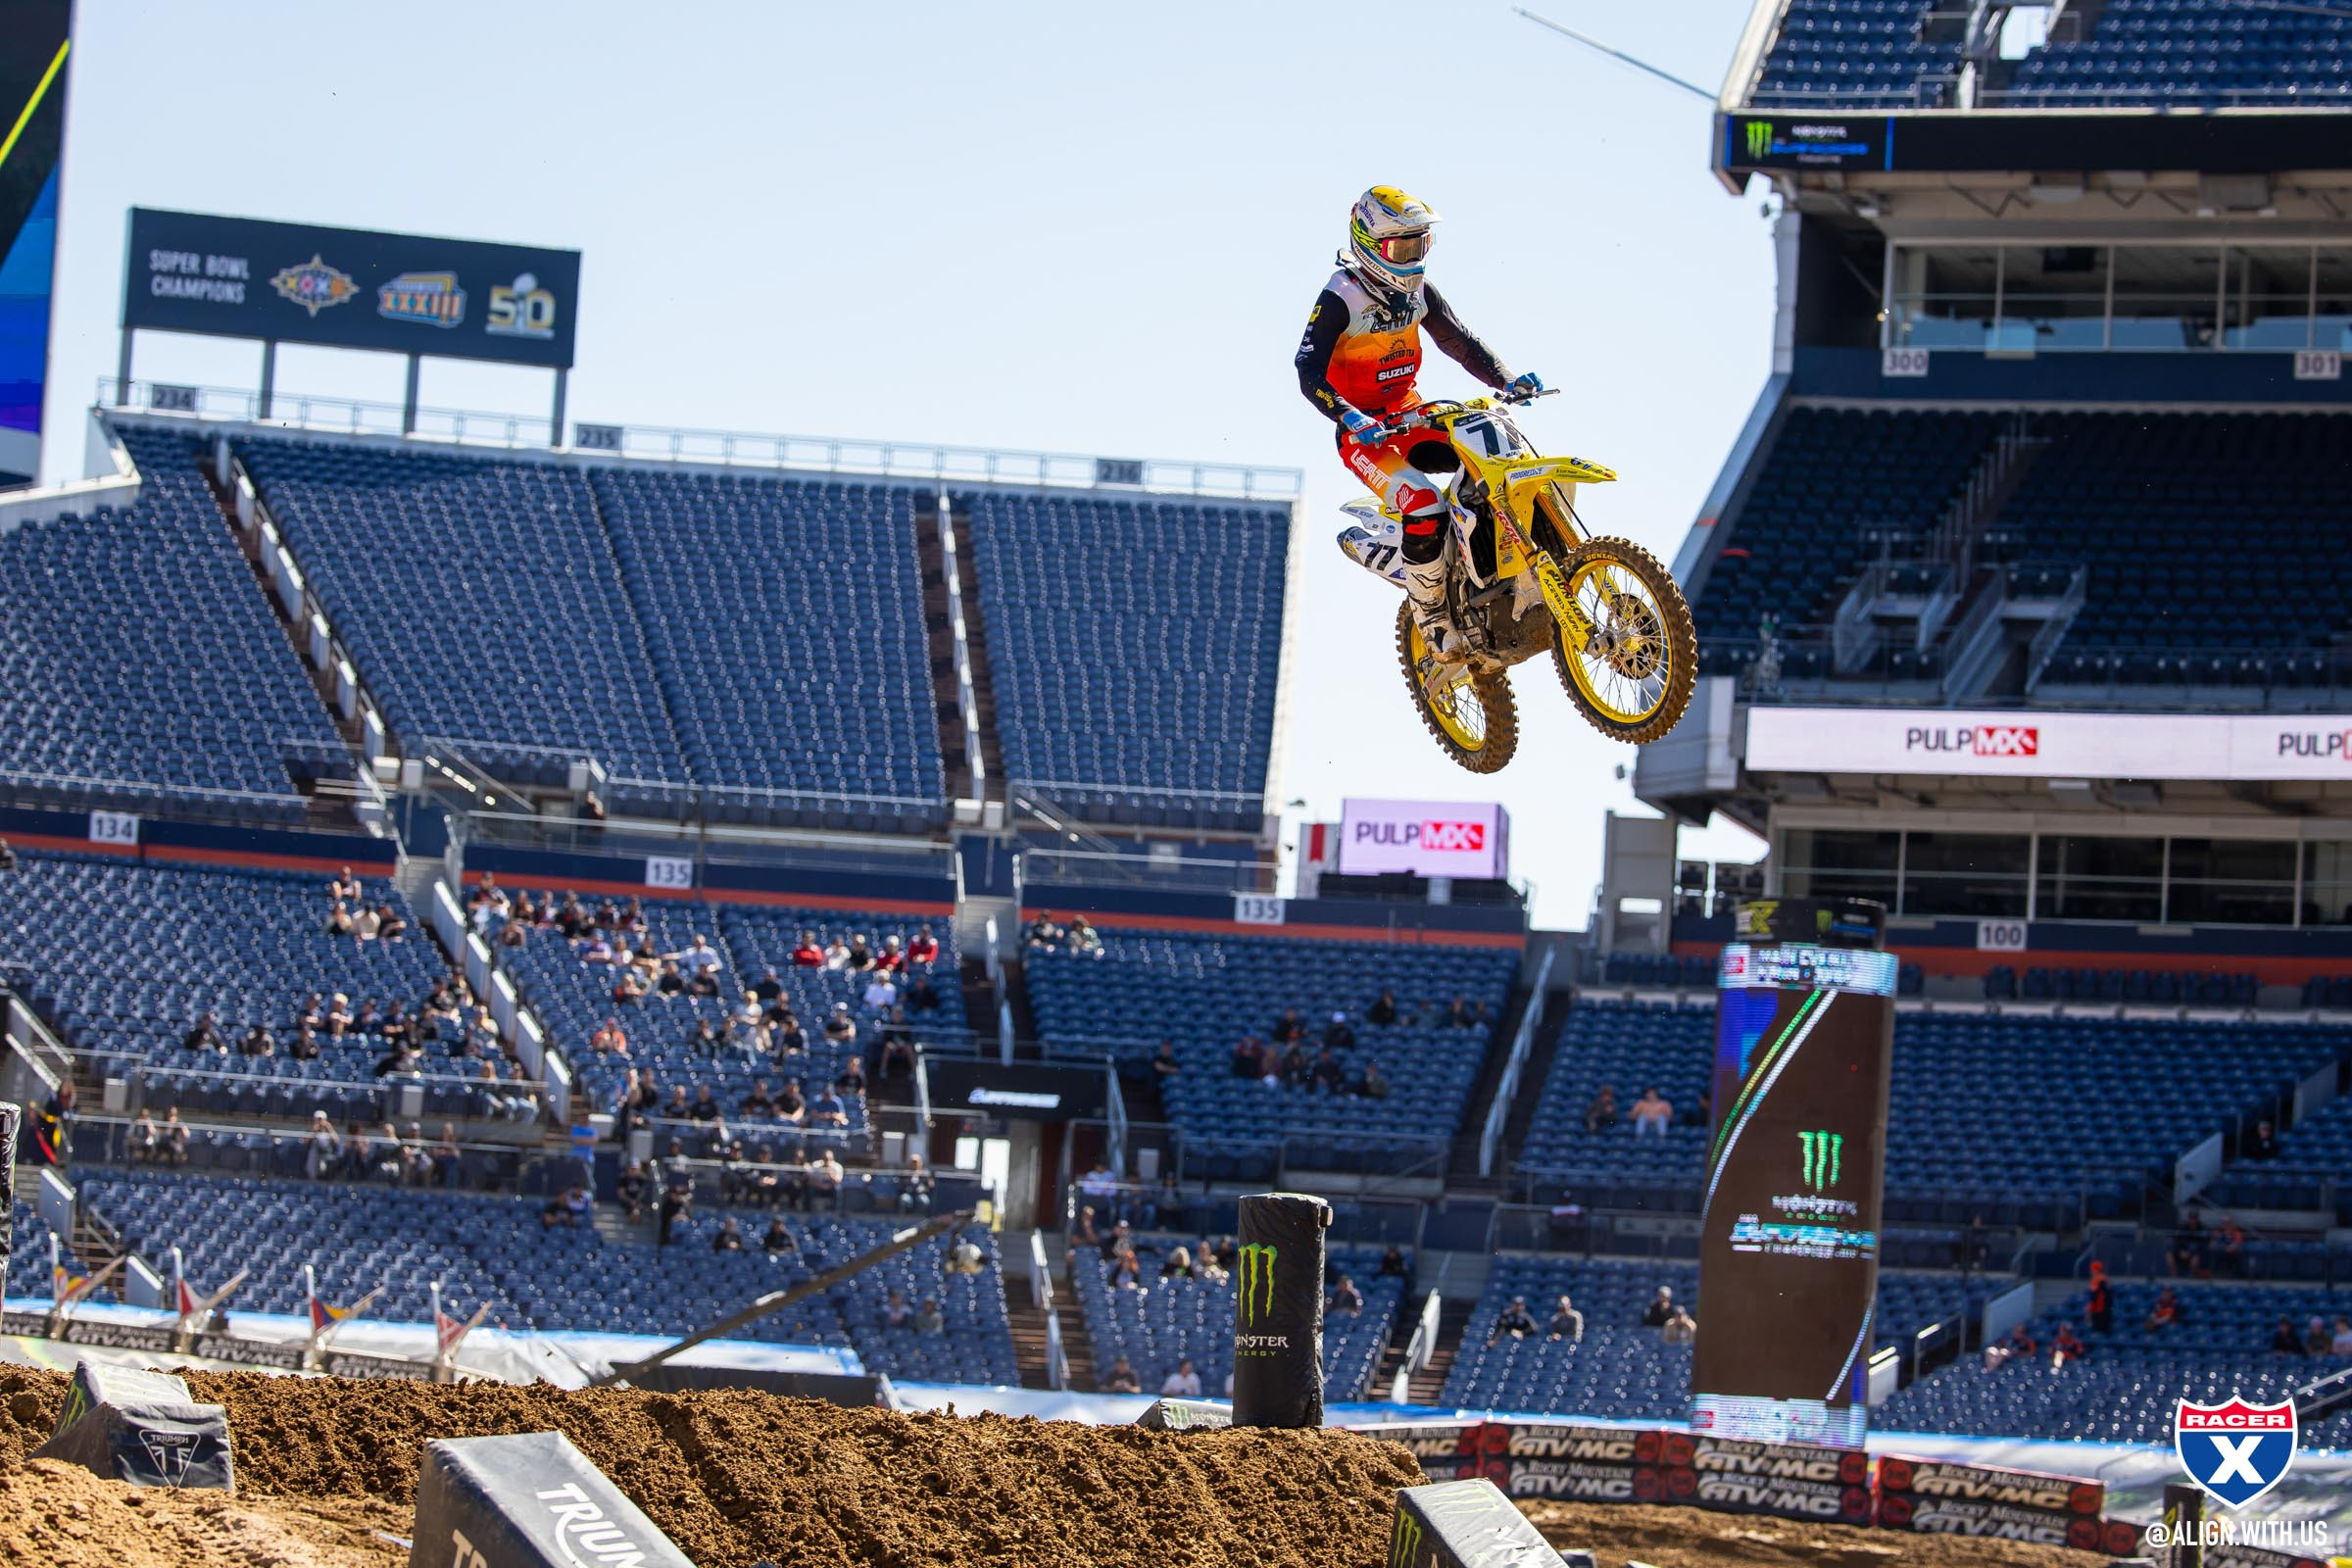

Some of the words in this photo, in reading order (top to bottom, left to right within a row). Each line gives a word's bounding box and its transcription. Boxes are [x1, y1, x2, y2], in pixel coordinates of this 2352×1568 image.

[150, 249, 200, 274] SUPER
[205, 254, 250, 280] BOWL
[1354, 245, 1388, 276] PROGRESSIVE
[151, 274, 245, 305] CHAMPIONS
[1379, 349, 1406, 366] TWISTED
[1888, 352, 1928, 371] 300
[2299, 354, 2336, 374] 301
[1378, 364, 1415, 381] SUZUKI
[1350, 448, 1393, 489] LEATT
[1365, 541, 1398, 571] 77
[1586, 553, 1619, 562] DUNLOP
[1544, 578, 1565, 610] ACERBIS
[96, 816, 132, 839] 134
[654, 862, 689, 884] 135
[1243, 898, 1279, 919] 135
[1984, 924, 2022, 946] 100
[1235, 1334, 1289, 1348] ONSTER
[1191, 1412, 1232, 1423] MONSTE
[150, 1434, 189, 1446] TRIUMPH
[1530, 1424, 1568, 1438] ROCKY
[1569, 1427, 1636, 1441] MOUNTAIN
[1717, 1439, 1761, 1455] ROCKY
[1765, 1443, 1840, 1461] MOUNTAIN
[1529, 1460, 1566, 1474] ROCKY
[1568, 1463, 1633, 1478] MOUNTAIN
[1938, 1464, 1986, 1483] ROCKY
[1989, 1471, 2070, 1492] MOUNTAIN
[1721, 1472, 1765, 1489] ROCKY
[1767, 1477, 1842, 1495] MOUNTAIN
[1938, 1499, 1985, 1517] ROCKY
[1989, 1504, 2068, 1527] MOUNTAIN
